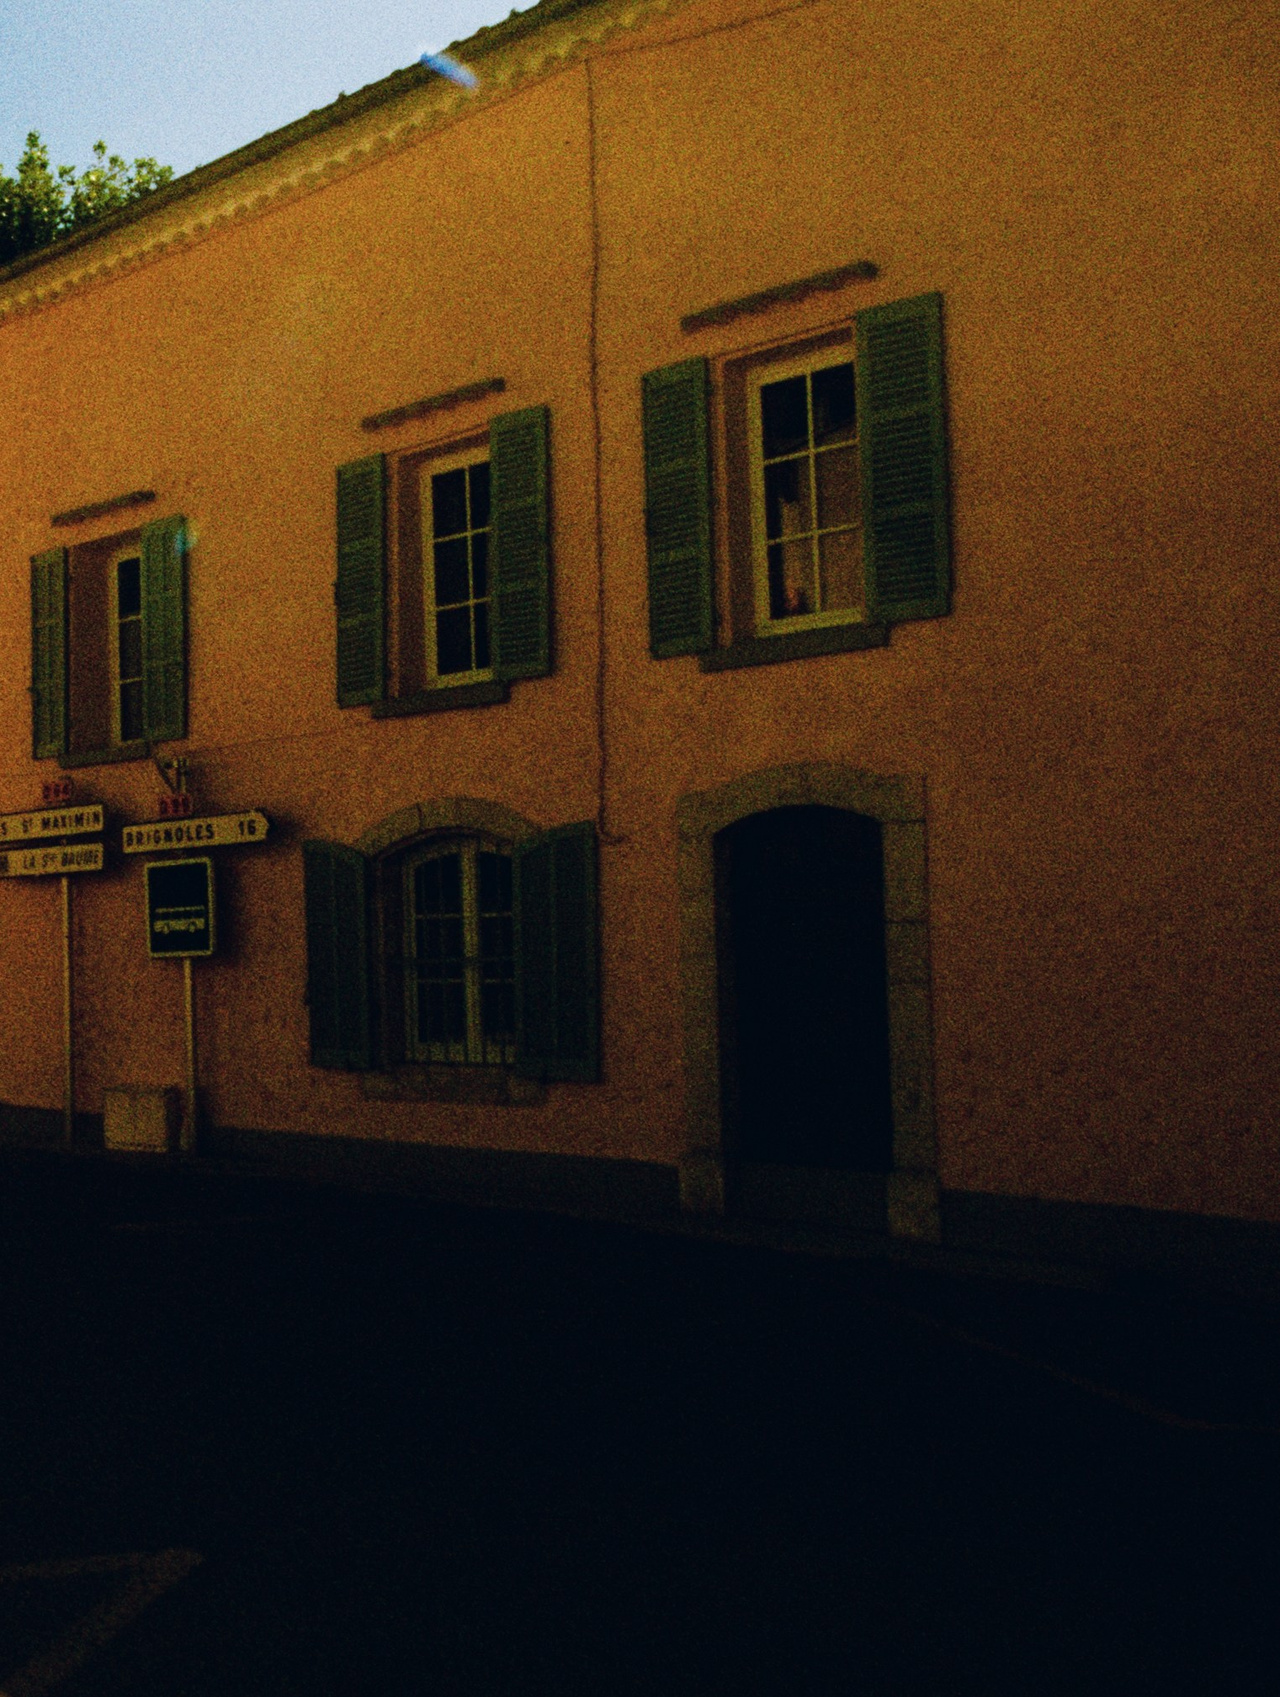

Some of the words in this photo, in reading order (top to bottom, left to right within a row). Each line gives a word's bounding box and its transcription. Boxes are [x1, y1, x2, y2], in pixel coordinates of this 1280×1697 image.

[41, 811, 100, 830] MAXIMIN
[125, 823, 215, 848] BRIGNOLES
[238, 819, 257, 836] 16
[22, 855, 36, 870] LA
